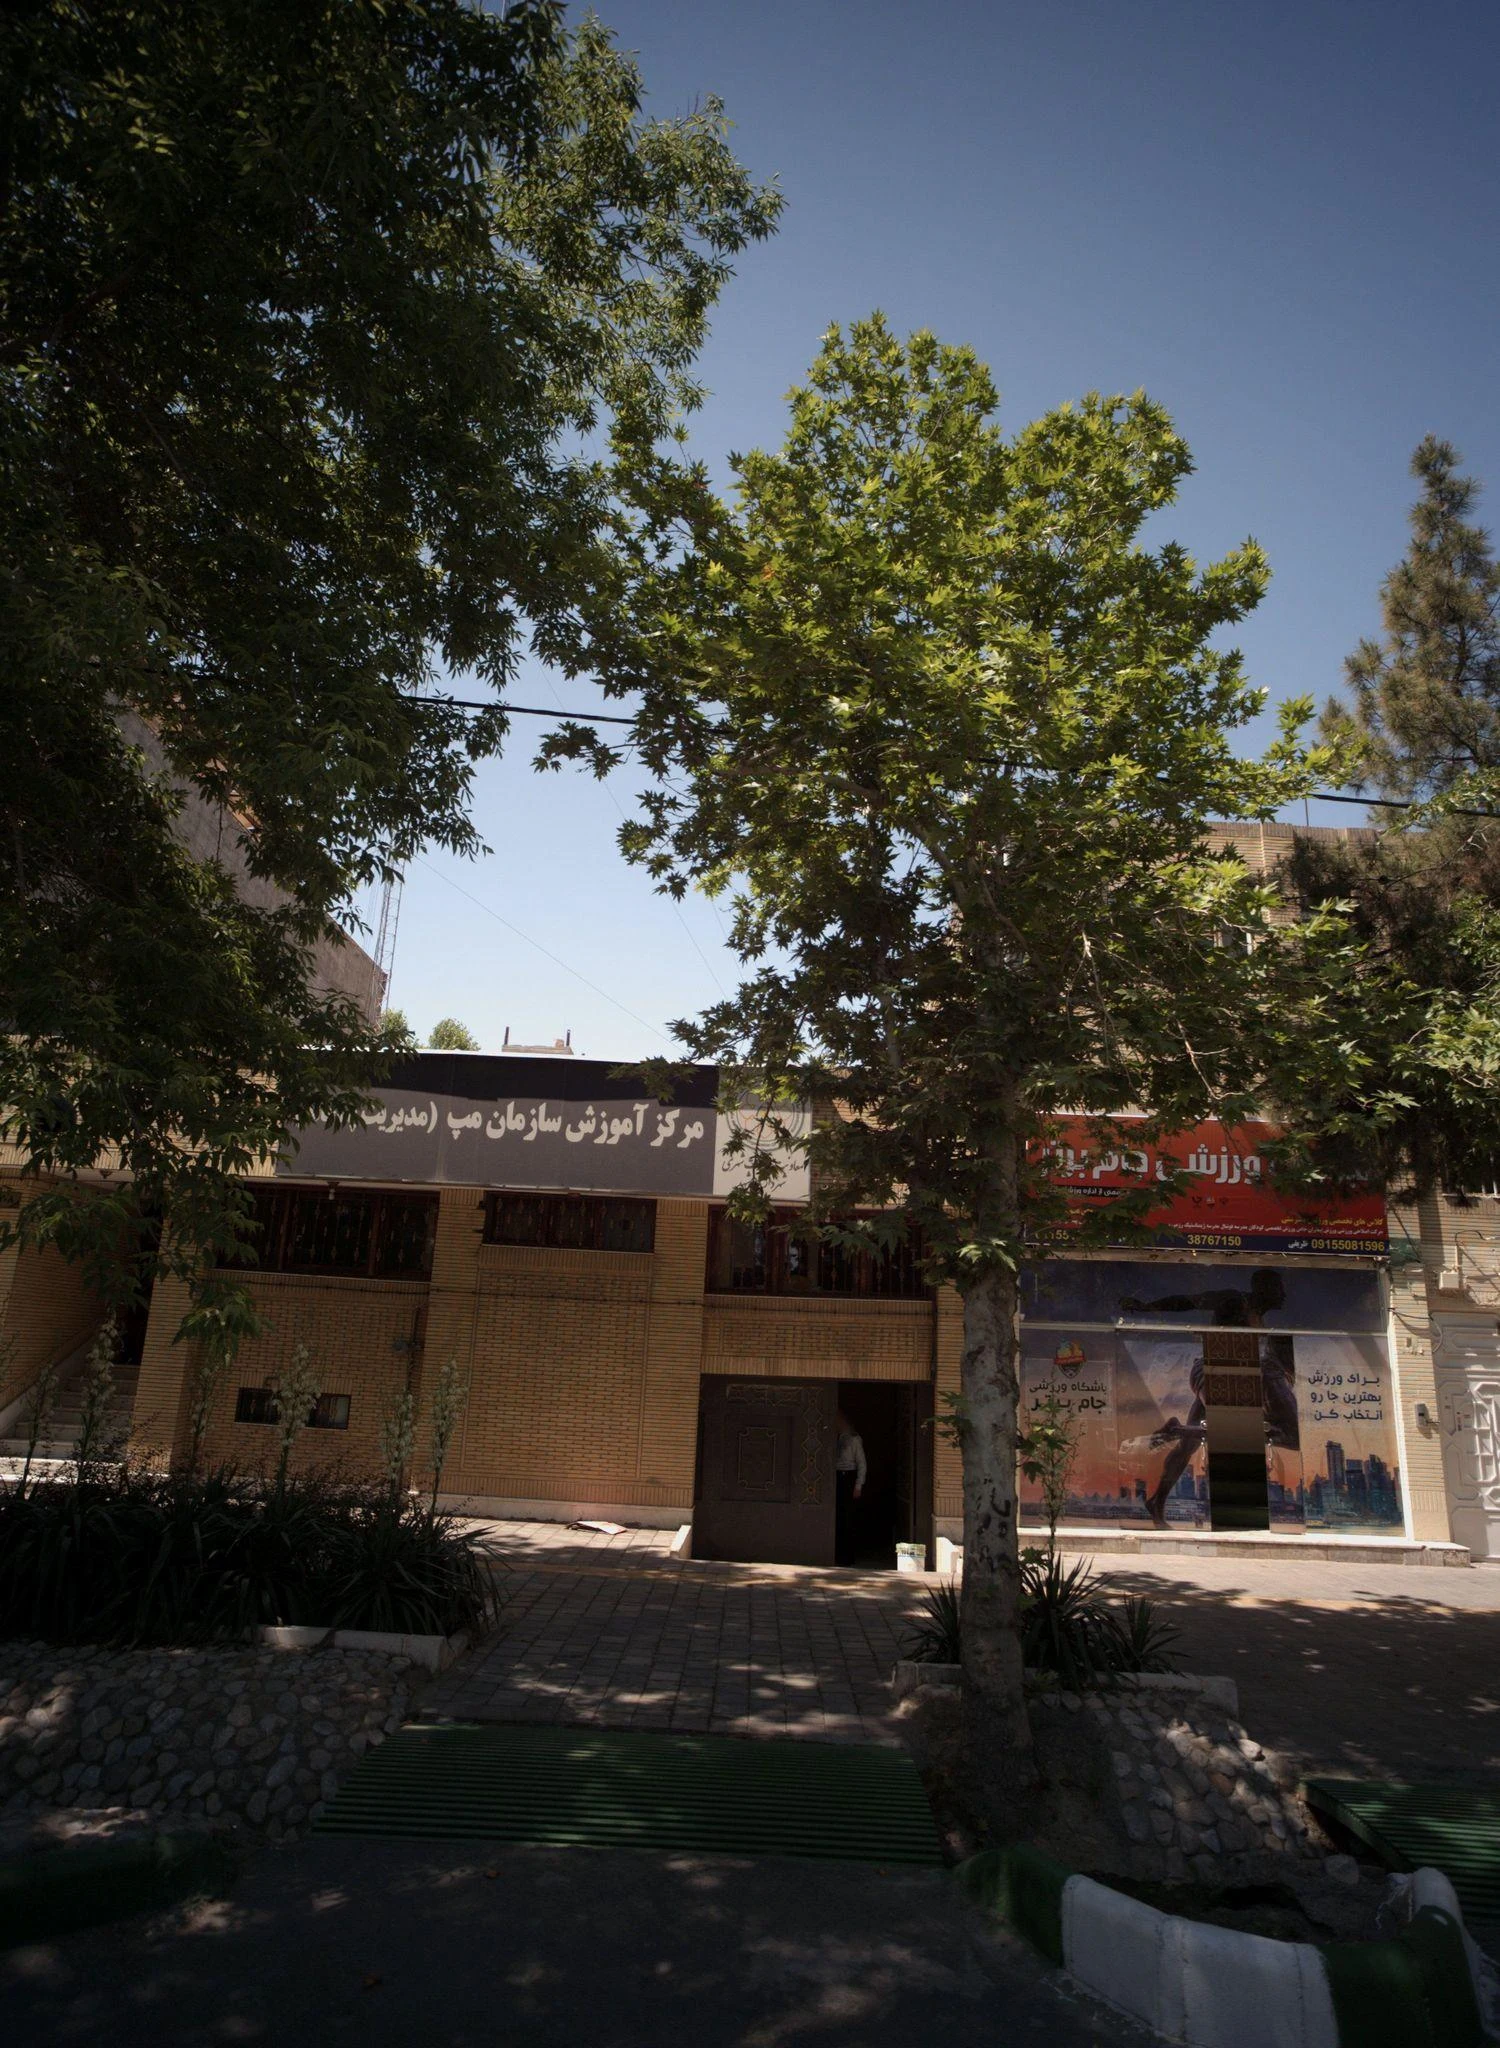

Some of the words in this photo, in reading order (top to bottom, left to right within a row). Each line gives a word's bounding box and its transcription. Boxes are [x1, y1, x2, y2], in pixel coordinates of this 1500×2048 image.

[447, 1110, 482, 1140] مپ
[485, 1101, 562, 1141] سازمان
[565, 1103, 649, 1144] آموزش
[650, 1109, 704, 1148] مرکز
[1187, 1234, 1242, 1247] 38767150
[1311, 1238, 1385, 1252] 09155081596
[1308, 1370, 1343, 1385] ورزش
[1347, 1373, 1380, 1387] برای
[1029, 1378, 1067, 1393] ورزشی
[1071, 1379, 1107, 1395] باشگاه
[1310, 1392, 1323, 1403] رو
[1327, 1391, 1338, 1403] جا
[1343, 1391, 1382, 1405] بهترین
[1078, 1396, 1106, 1414] جام
[1314, 1409, 1339, 1421] کن
[1343, 1409, 1383, 1423] انتخاب
